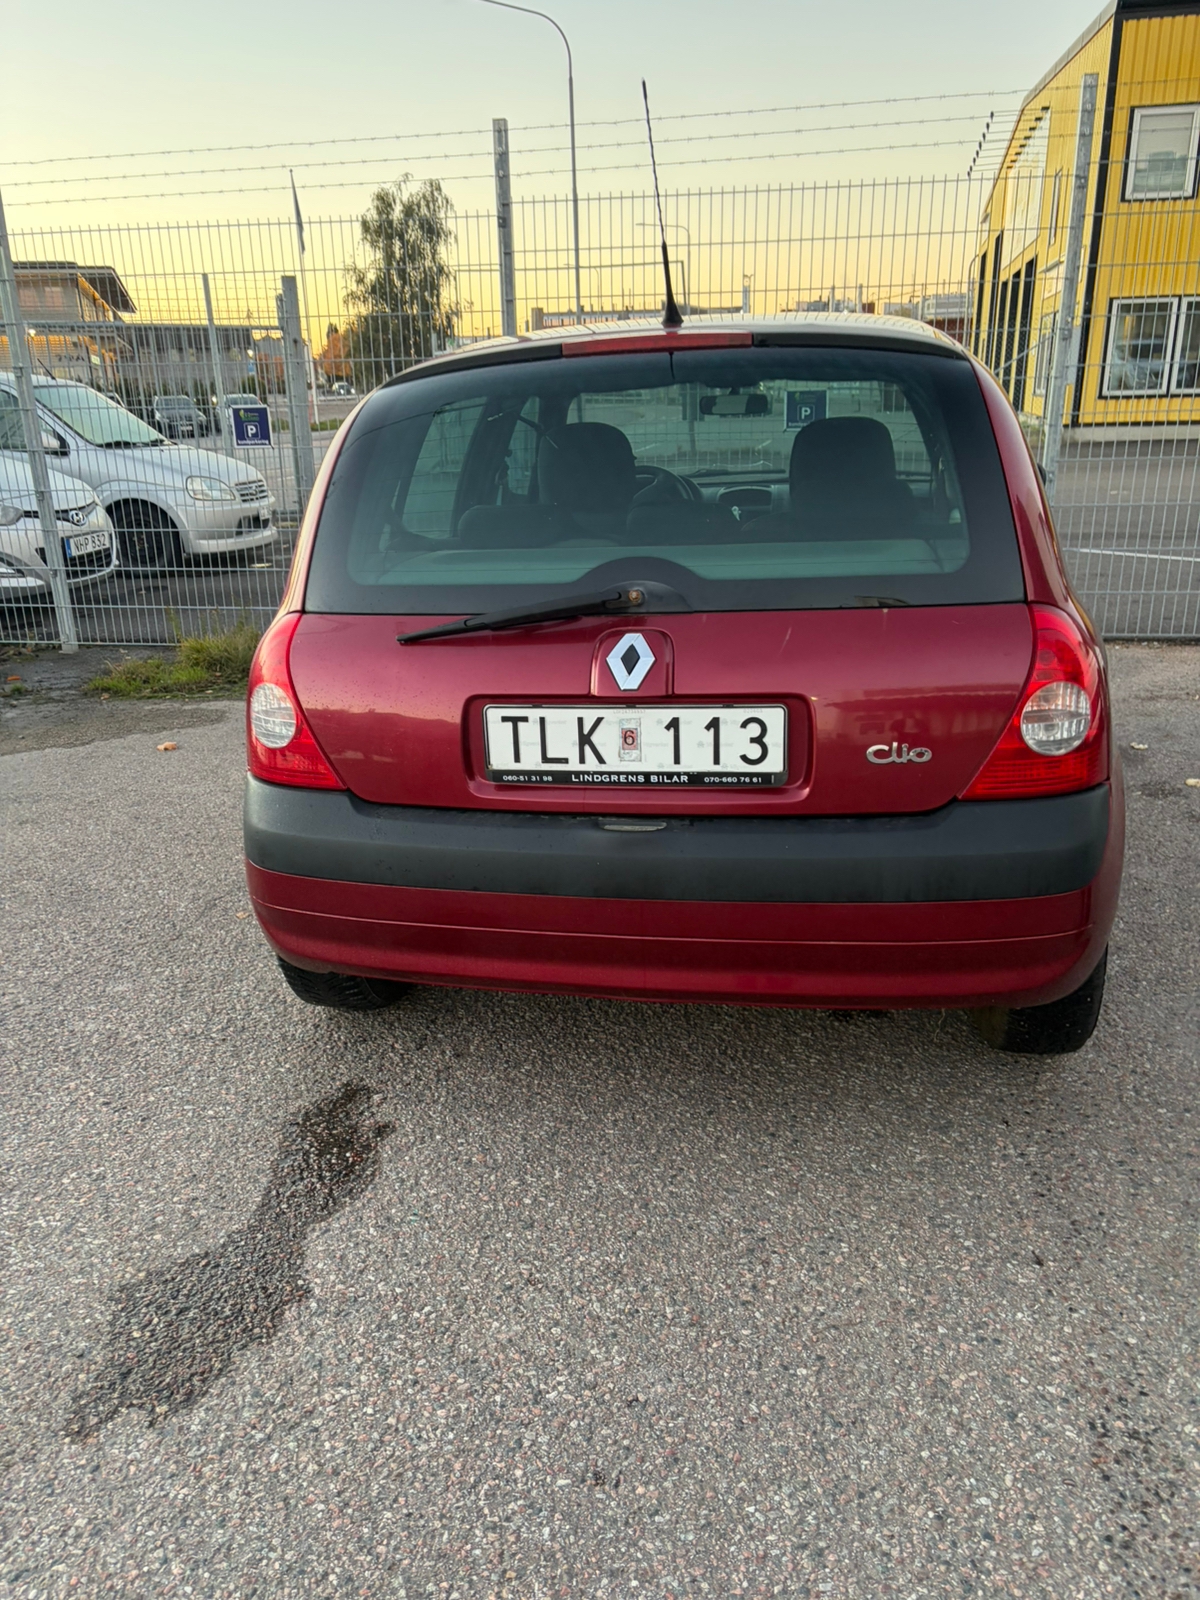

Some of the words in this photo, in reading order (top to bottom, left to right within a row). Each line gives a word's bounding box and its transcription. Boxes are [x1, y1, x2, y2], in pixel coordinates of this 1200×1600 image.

[802, 407, 811, 420] P
[247, 425, 257, 438] P
[501, 716, 607, 765] TLK
[664, 716, 769, 766] 113
[624, 729, 635, 746] 6
[866, 741, 932, 764] Clio
[502, 774, 529, 782] 060-51
[571, 773, 646, 784] LINDGRENS
[650, 774, 689, 784] BILAR
[703, 776, 739, 784] 070-660
[739, 776, 751, 784] 76
[752, 776, 763, 784] 61
